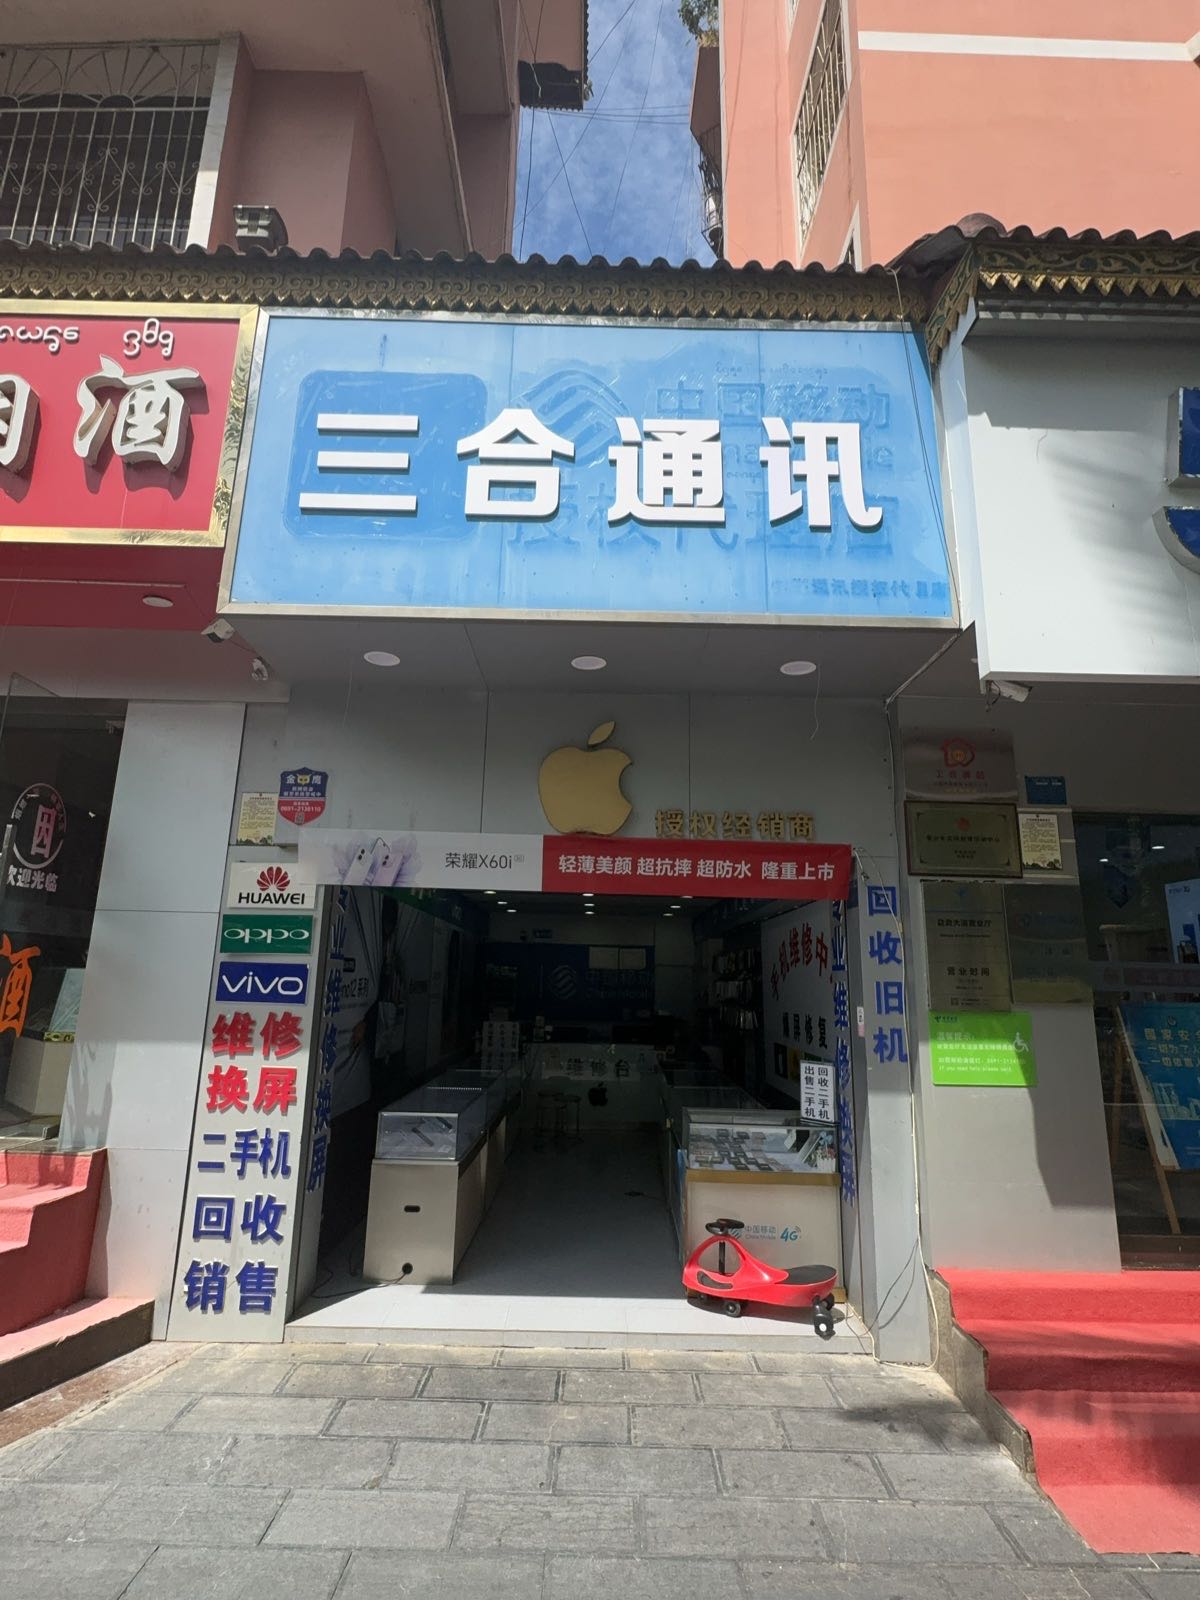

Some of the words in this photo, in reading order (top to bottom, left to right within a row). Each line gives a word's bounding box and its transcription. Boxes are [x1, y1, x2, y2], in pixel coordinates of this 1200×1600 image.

[0, 354, 201, 467] 酒
[299, 407, 883, 530] 三合通讯
[655, 809, 815, 840] 授权经销商
[445, 851, 512, 870] 荣耀X60i
[558, 855, 632, 876] 轻薄美颜
[636, 857, 692, 878] 超抗摔
[696, 859, 752, 879] 超防水
[761, 861, 835, 881] 隆重上市
[238, 892, 305, 904] HUAWEI
[222, 972, 304, 996] vivo
[770, 922, 833, 1001] 手机维修中
[867, 885, 909, 1064] 回收旧机
[212, 1010, 303, 1060] 维修
[206, 1065, 298, 1115] 换屏
[804, 1065, 816, 1118] 出售二手机
[817, 1066, 830, 1120] 回收二手机
[197, 1127, 292, 1180] 二手机
[192, 1193, 287, 1244] 回收
[780, 1227, 799, 1242] 4G
[184, 1260, 279, 1315] 销售
